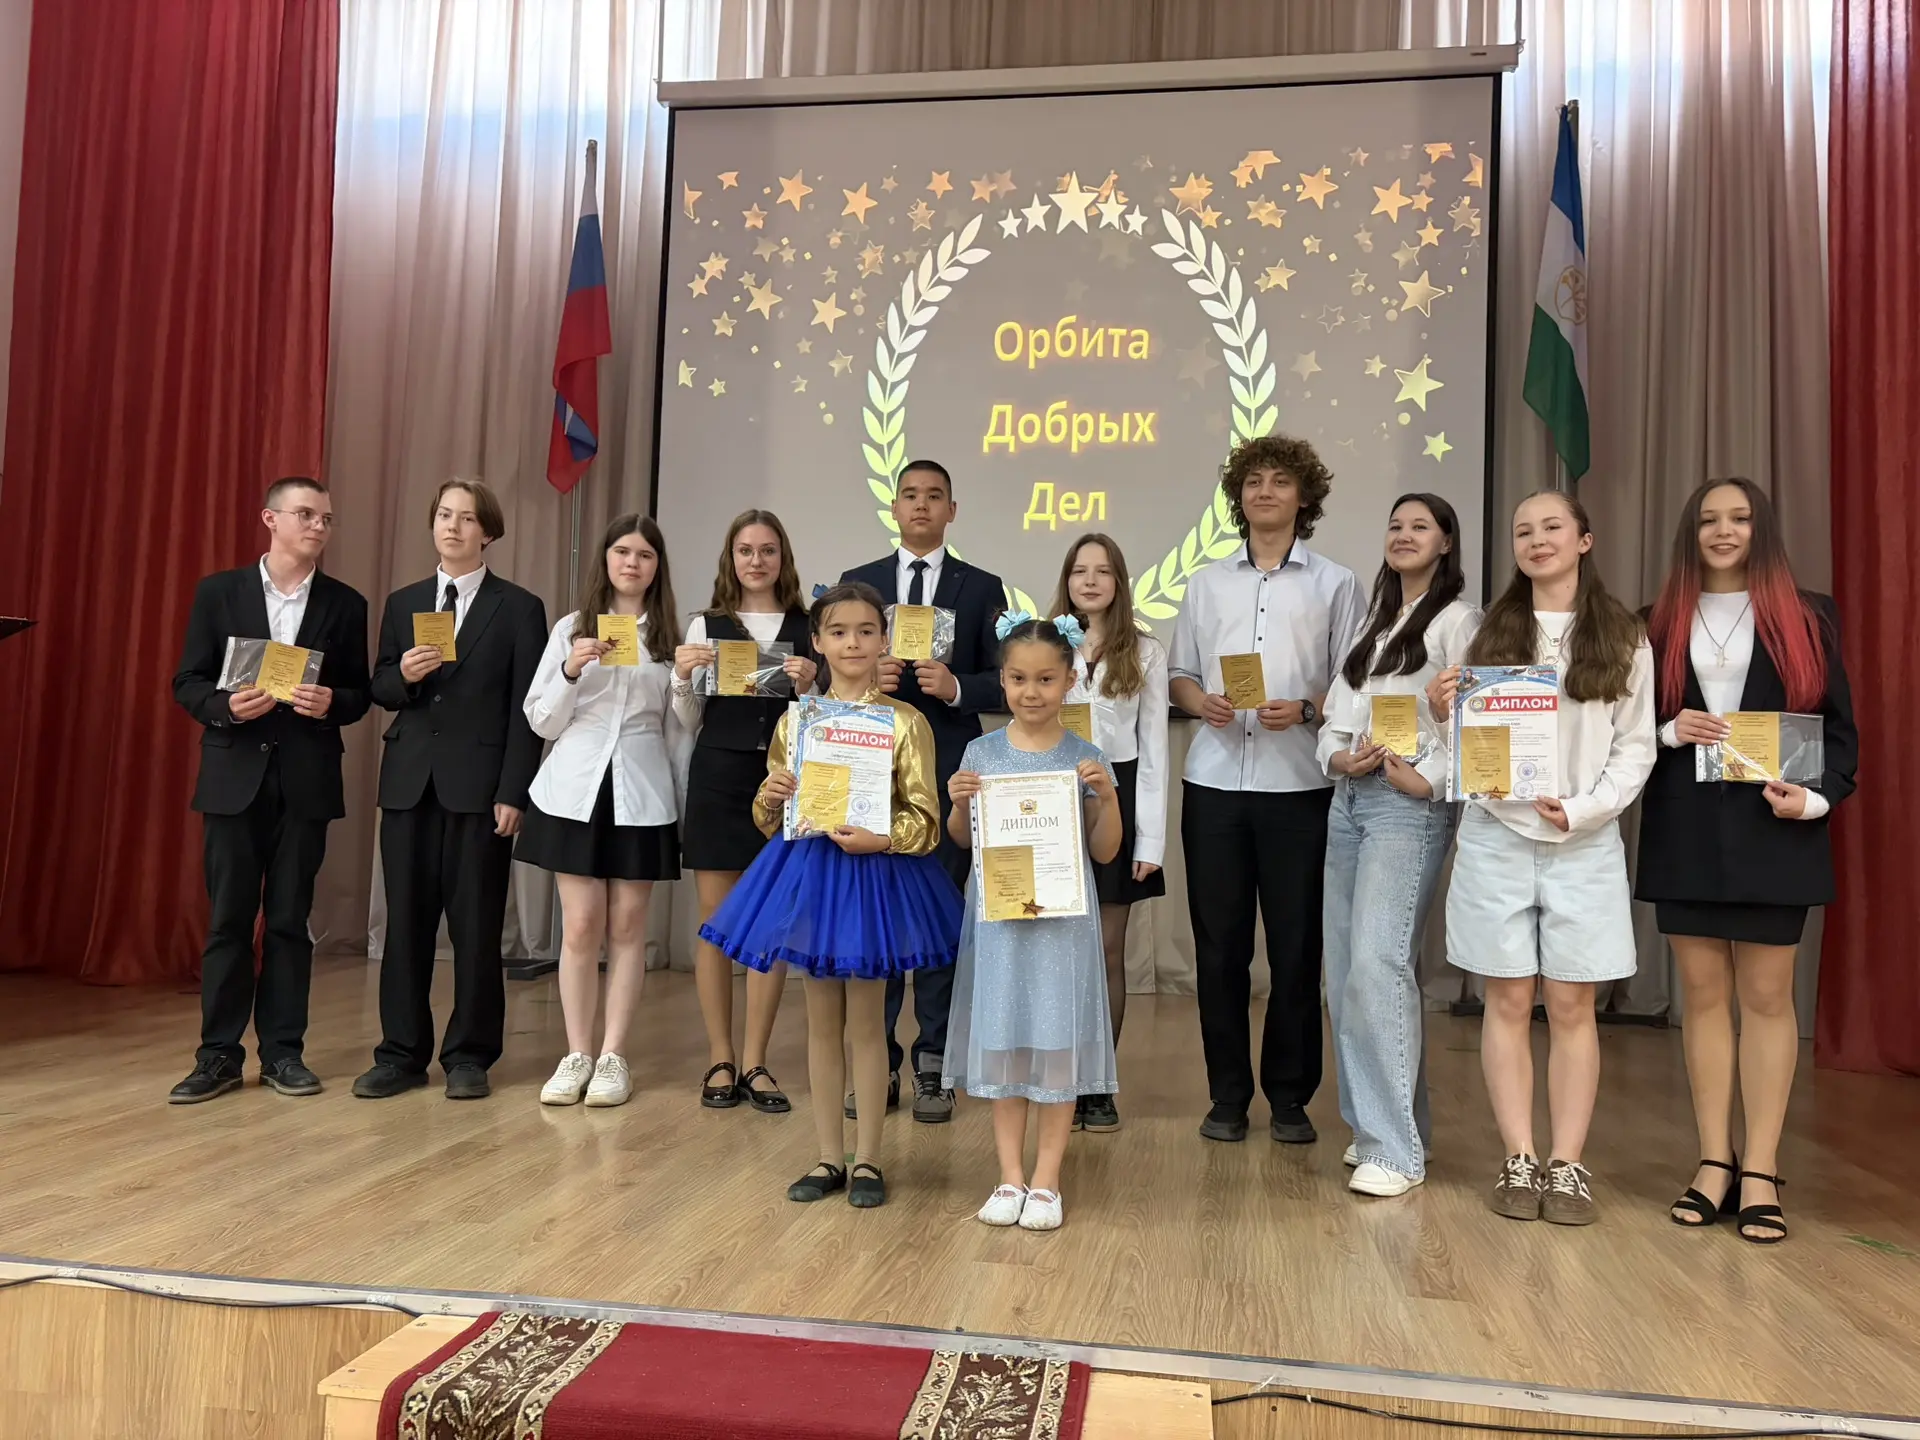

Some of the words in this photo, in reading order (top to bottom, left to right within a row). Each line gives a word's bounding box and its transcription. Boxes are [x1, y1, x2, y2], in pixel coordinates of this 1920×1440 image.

[994, 315, 1149, 369] Орбита
[983, 401, 1156, 453] Добрых
[1023, 482, 1106, 530] Дел
[1489, 698, 1553, 710] ДИПЛОМ
[830, 731, 889, 747] ДИПЛОМ
[1000, 816, 1059, 832] ДИПЛОМ
